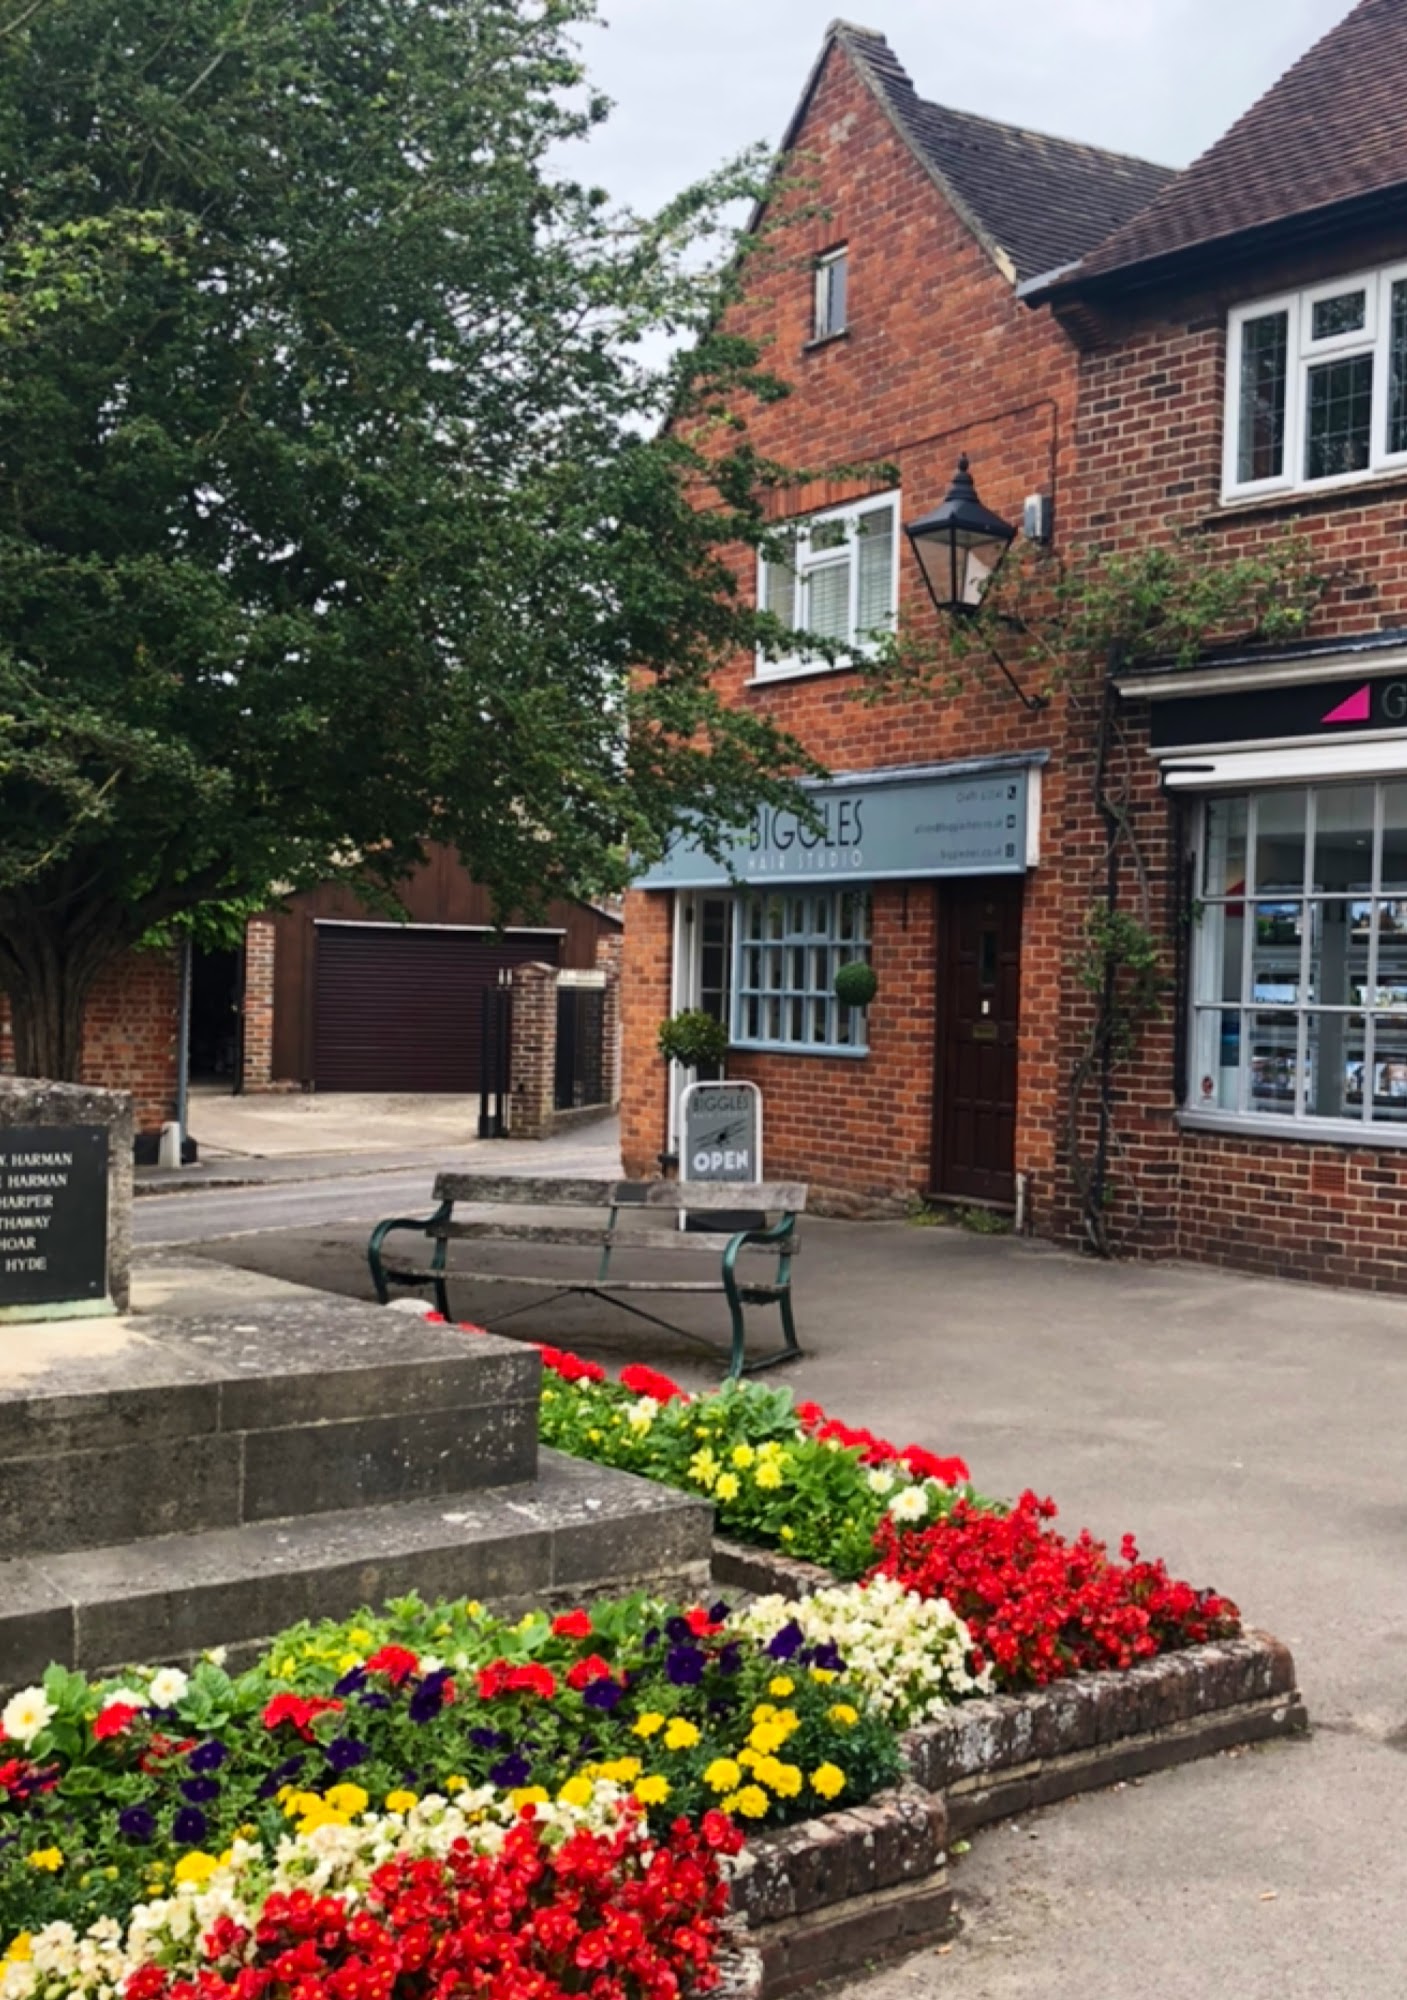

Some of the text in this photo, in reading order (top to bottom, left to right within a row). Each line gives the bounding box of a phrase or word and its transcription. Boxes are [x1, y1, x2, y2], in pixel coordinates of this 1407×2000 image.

[748, 848, 863, 871] HAIR STUDIO
[692, 1095, 749, 1113] BIGGLES
[11, 1151, 73, 1168] HARMAN
[693, 1149, 749, 1172] OPEN
[7, 1172, 68, 1189] HARMAN
[5, 1256, 48, 1274] HYDE
